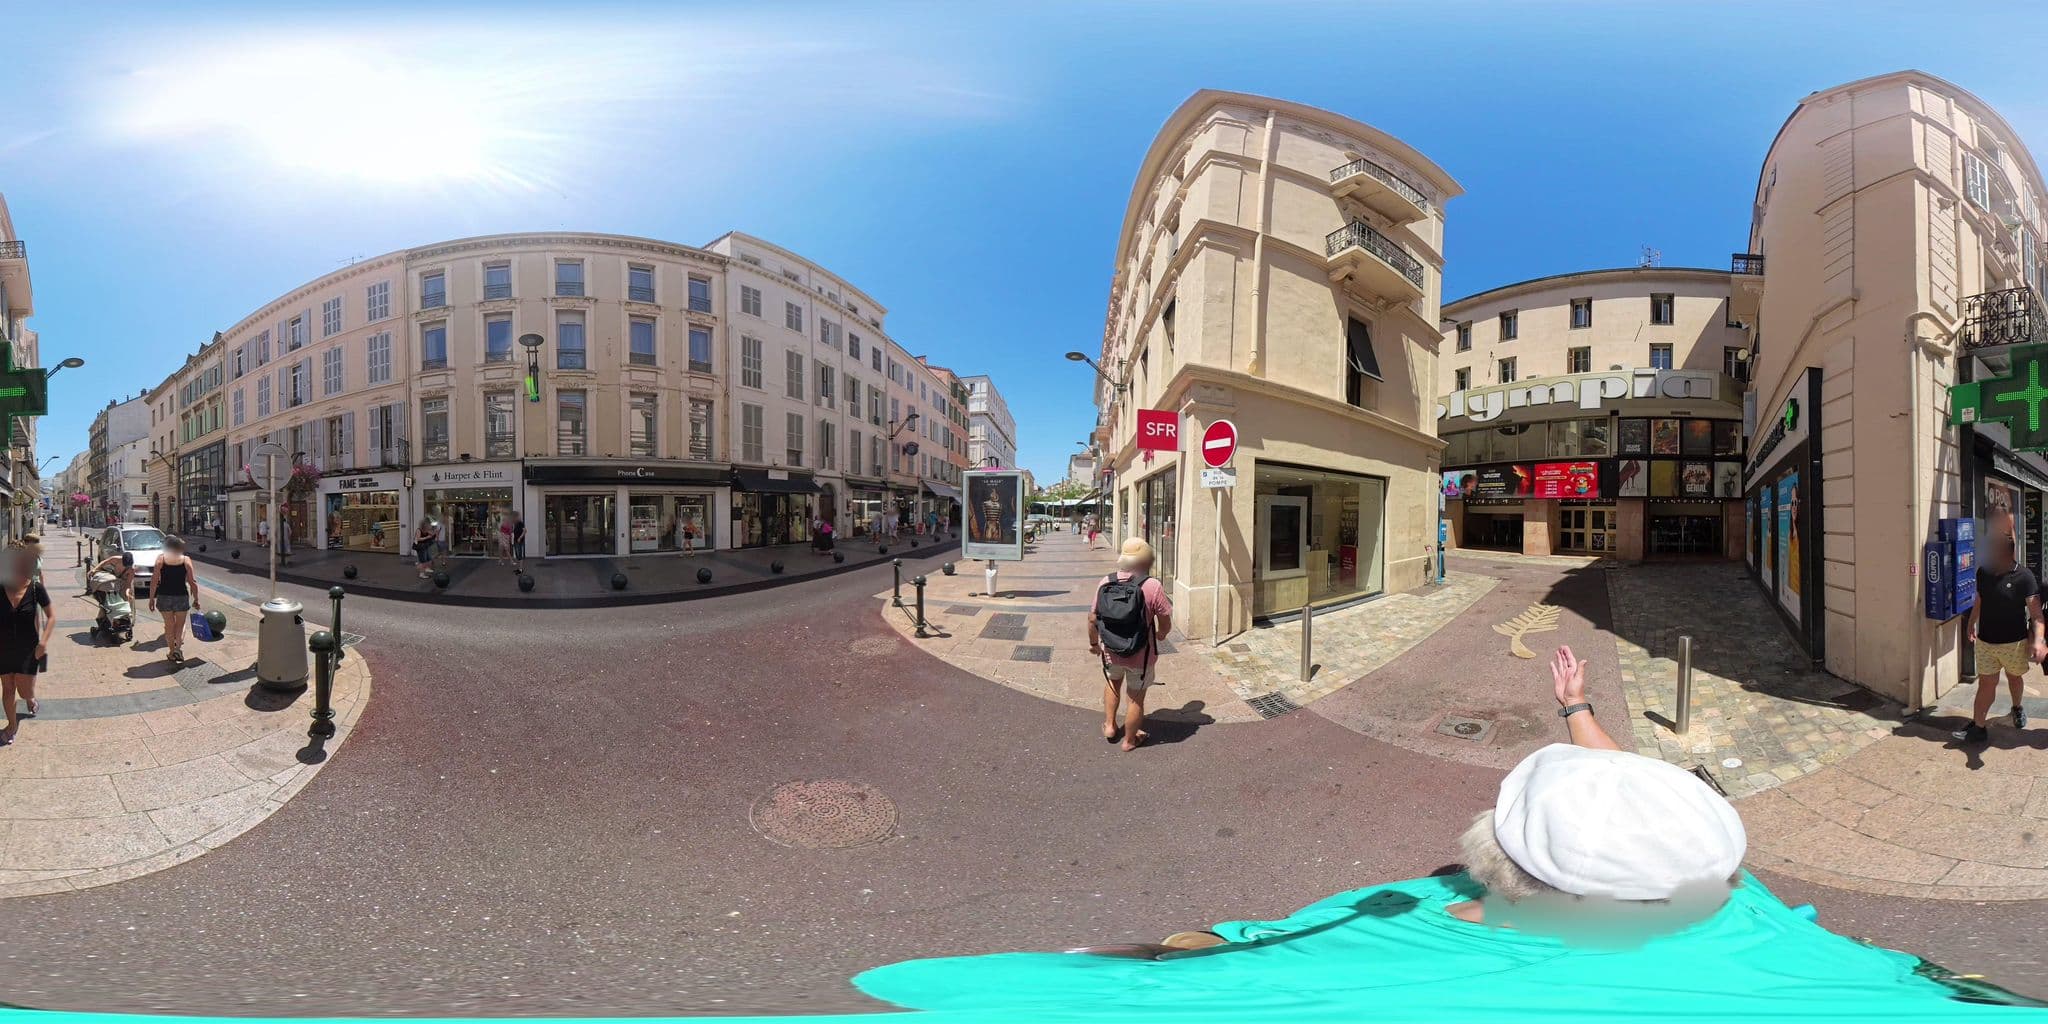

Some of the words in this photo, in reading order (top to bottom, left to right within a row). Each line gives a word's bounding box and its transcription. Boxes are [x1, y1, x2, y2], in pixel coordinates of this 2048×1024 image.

[1438, 368, 1712, 421] lympia
[1146, 421, 1177, 437] SFR
[444, 472, 471, 481] Harper
[473, 471, 480, 479] &
[483, 470, 503, 479] Flint
[339, 479, 357, 489] FAME
[1929, 553, 1937, 580] durex
